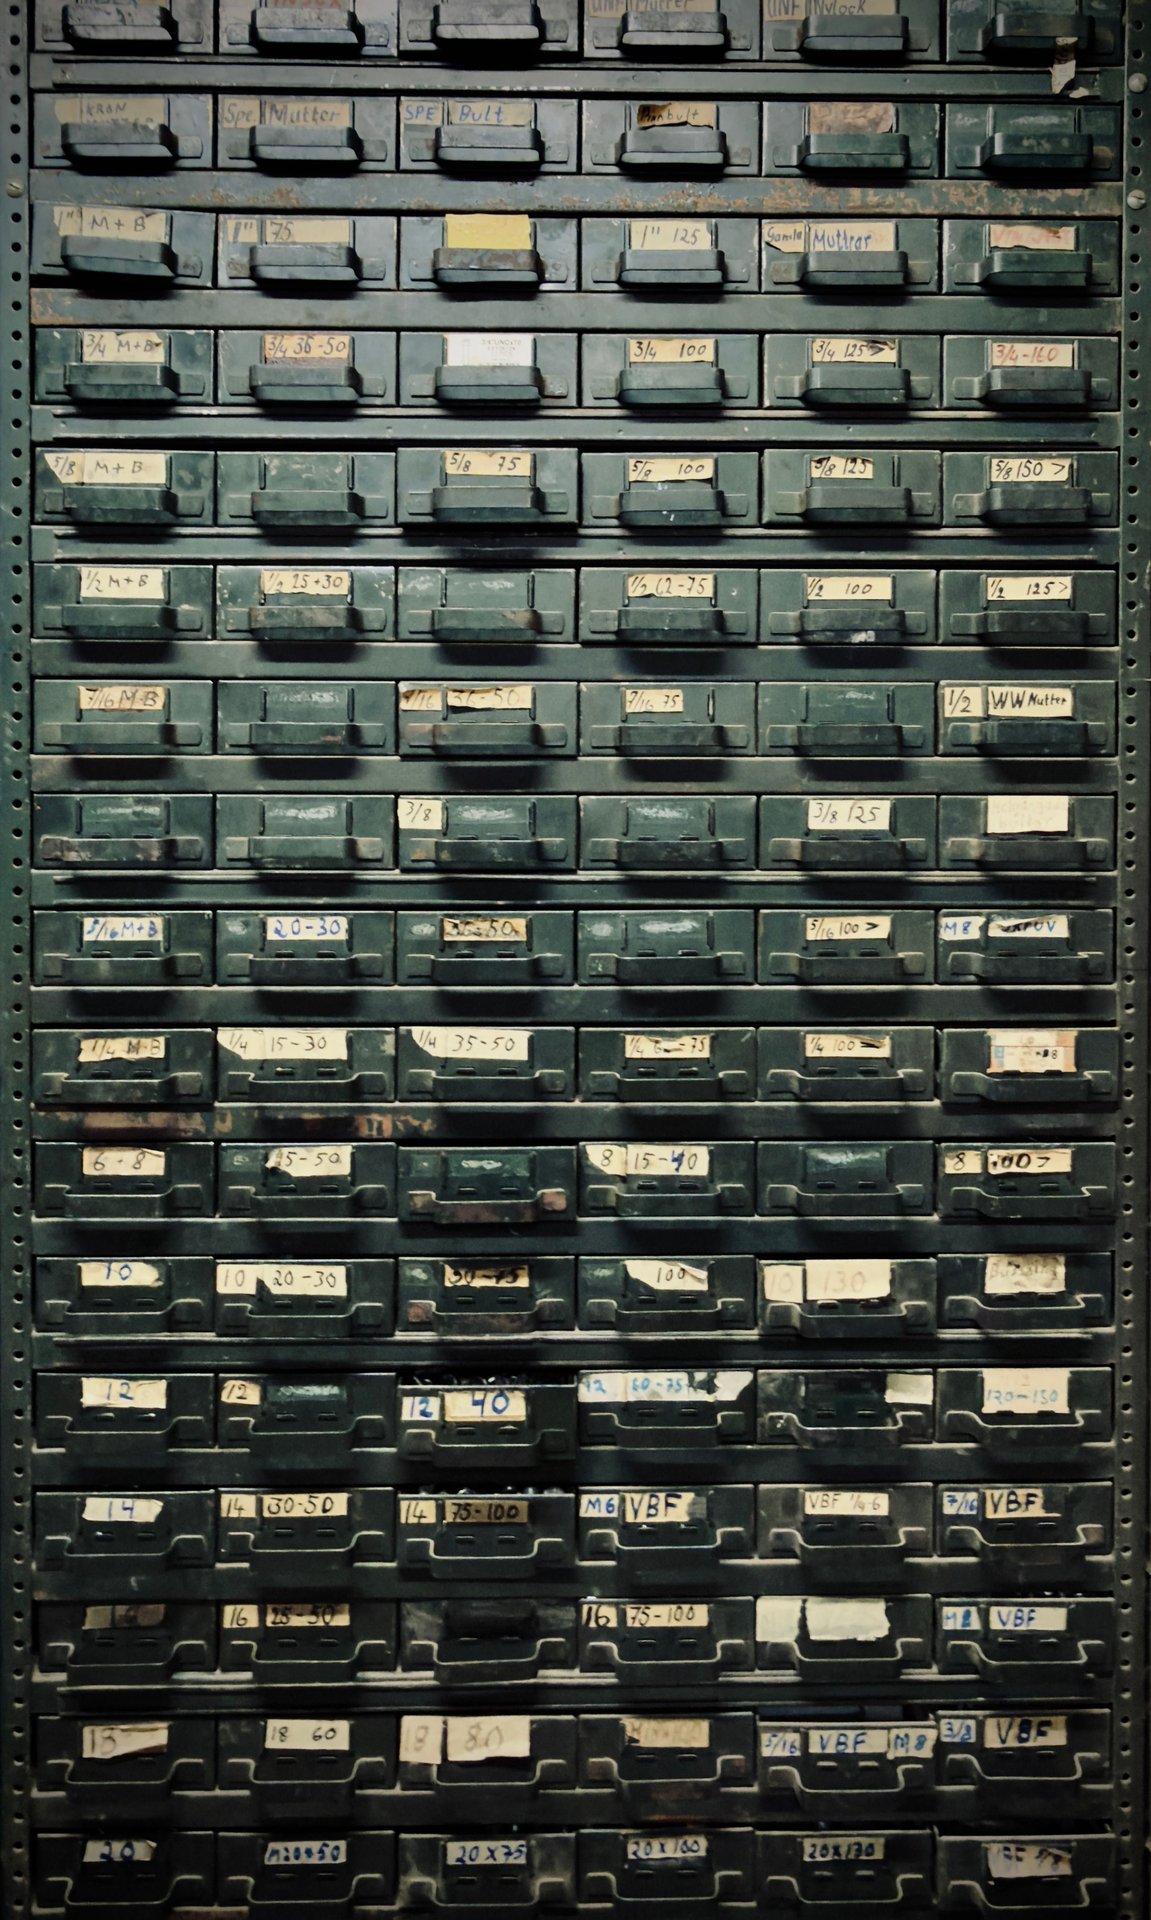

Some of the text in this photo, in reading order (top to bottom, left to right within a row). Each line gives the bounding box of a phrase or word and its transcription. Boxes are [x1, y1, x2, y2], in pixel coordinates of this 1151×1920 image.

[404, 104, 505, 123] SPE Bult
[270, 222, 295, 241] 75
[673, 227, 699, 244] 125
[85, 332, 107, 357] 3/4
[634, 340, 707, 359] 3/4 100
[815, 342, 835, 362] 3/4
[450, 453, 471, 473] 5/8
[679, 463, 706, 475] 100
[846, 584, 874, 595] 100
[991, 578, 1007, 599] 1/2
[1027, 582, 1054, 597] 125
[949, 690, 972, 714] 1/2
[406, 800, 433, 823] 3/8
[815, 801, 839, 823] 3/8
[273, 917, 342, 938] 20-30
[451, 1034, 516, 1053] 35-50
[600, 1149, 612, 1167] 8
[953, 1152, 967, 1172] 8
[103, 1262, 132, 1281] 10
[223, 1268, 337, 1287] 10 20-30
[107, 1381, 135, 1401] 12
[227, 1382, 249, 1400] 12
[410, 1392, 511, 1418] 12 40
[108, 1498, 135, 1519] 14
[228, 1495, 335, 1514] 14 30-50
[406, 1500, 521, 1520] 14 75-100
[585, 1494, 682, 1519] M6 VBF
[809, 1494, 840, 1509] VBF
[991, 1493, 1039, 1514] VBF
[230, 1606, 248, 1625] 16
[584, 1605, 695, 1627] 16 75-100
[997, 1609, 1037, 1626] VBF
[312, 1727, 337, 1743] 60
[820, 1735, 869, 1752] VBF
[100, 1842, 136, 1862] 20
